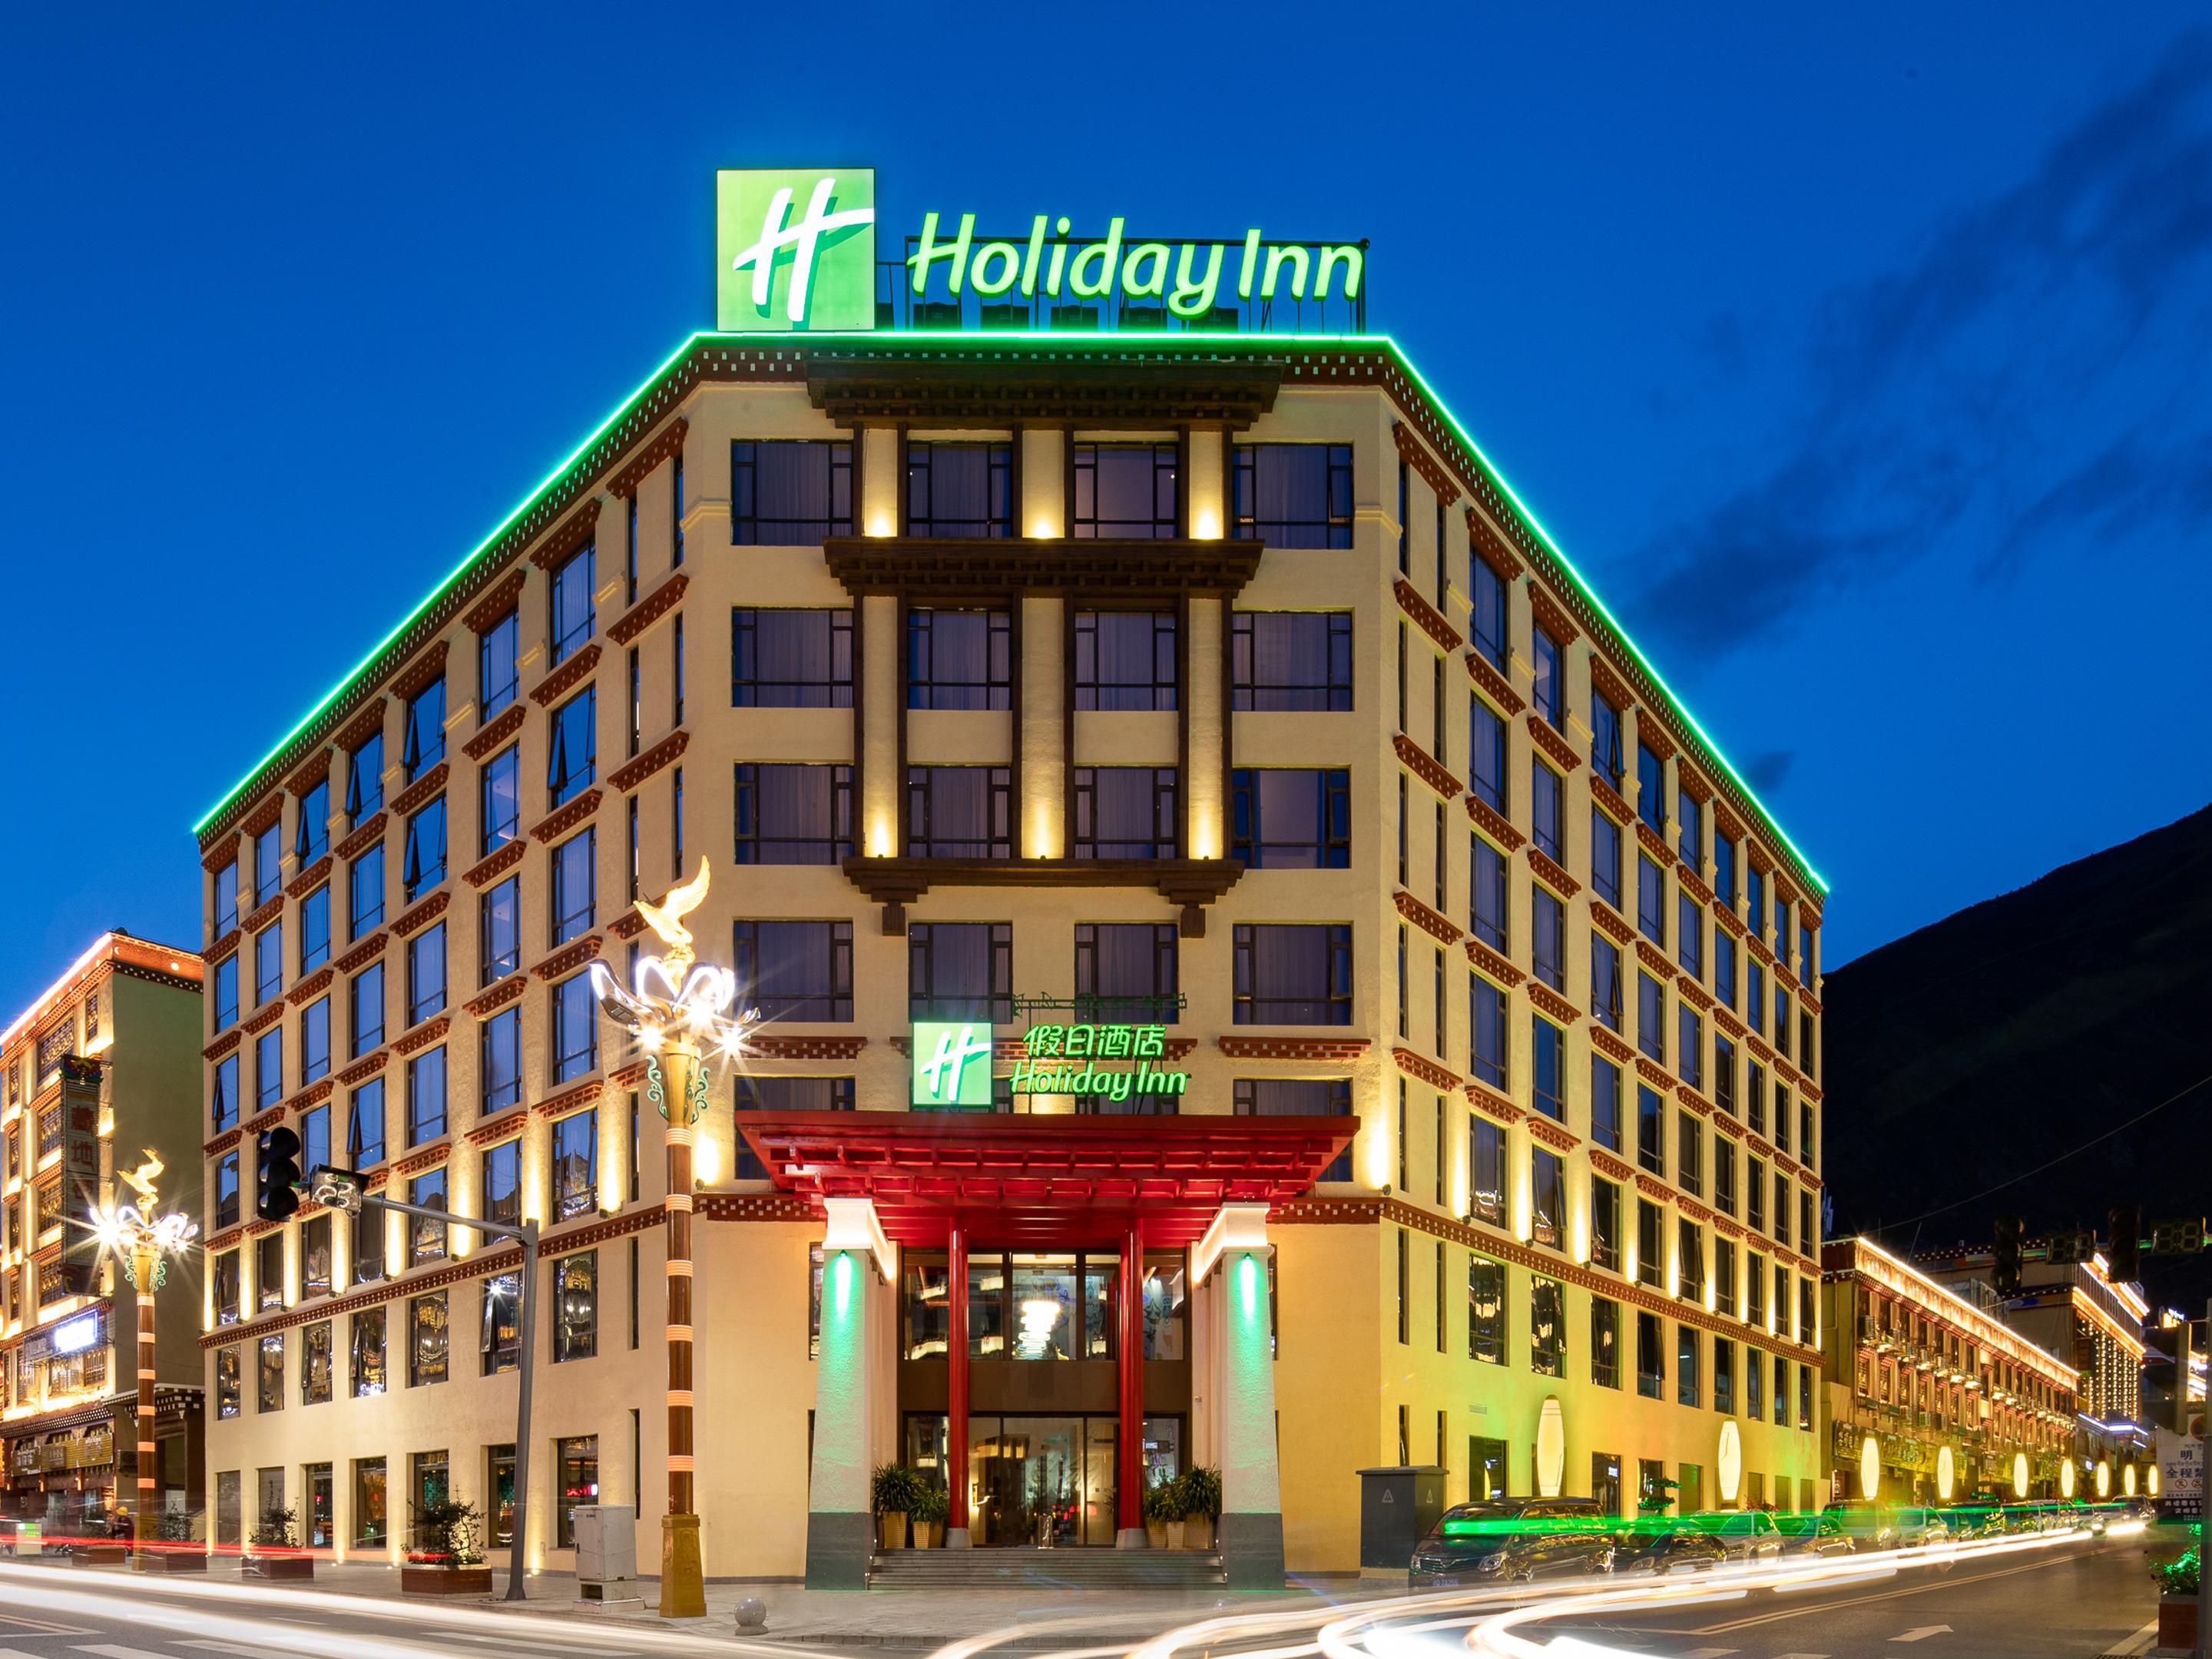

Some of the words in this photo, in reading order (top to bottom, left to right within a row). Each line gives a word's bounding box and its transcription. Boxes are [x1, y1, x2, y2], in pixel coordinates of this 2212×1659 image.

[906, 211, 1224, 320] Holiday
[1237, 228, 1365, 303] Inn
[1023, 1023, 1167, 1058] 假日酒店
[1009, 1061, 1133, 1102] Holiday
[1137, 1061, 1187, 1094] Inn
